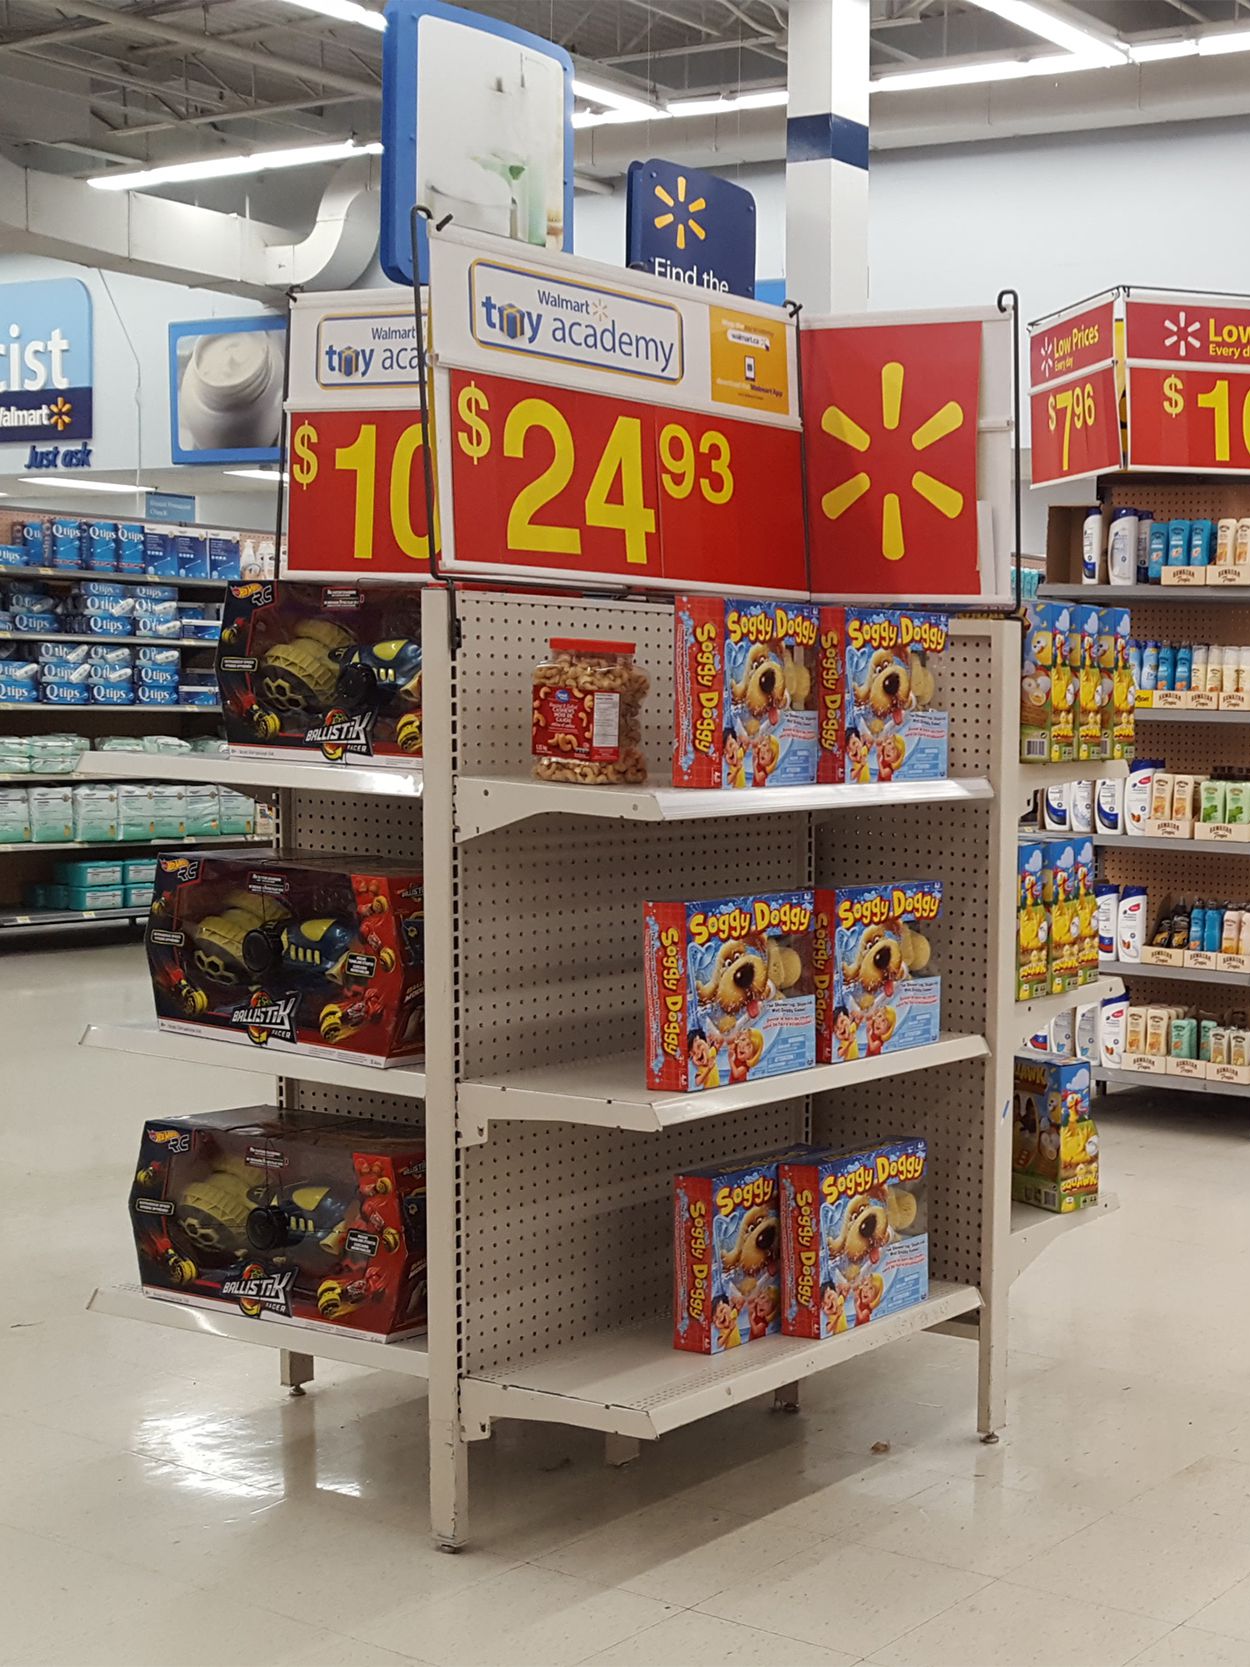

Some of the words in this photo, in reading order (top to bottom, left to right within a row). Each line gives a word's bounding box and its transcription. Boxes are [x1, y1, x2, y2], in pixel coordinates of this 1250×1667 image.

[655, 257, 697, 286] Find
[702, 269, 729, 292] the
[537, 289, 591, 316] Walmart
[371, 326, 416, 340] Walmart
[551, 315, 675, 373] academy
[1053, 336, 1072, 358] Low
[1072, 323, 1099, 351] Prices
[1209, 344, 1240, 359] Every
[25, 445, 59, 469] Just
[61, 441, 92, 467] ask
[727, 610, 774, 643] Soggy
[776, 609, 817, 645] Doggy
[848, 620, 898, 649] Soggy
[900, 617, 947, 652] Doggy
[696, 623, 717, 687] Soggy
[822, 631, 839, 689] Soggy
[696, 691, 719, 752] Doggy
[822, 694, 841, 751] Doggy
[689, 908, 751, 944] Soggy
[754, 901, 812, 934] Doggy
[838, 897, 890, 928] Soggy
[892, 890, 940, 920] Doggy
[661, 928, 679, 991] Soggy
[663, 995, 683, 1056] Doggy
[716, 1177, 774, 1217] Soggy
[822, 1166, 874, 1204] Soggy
[876, 1156, 923, 1184] Doggy
[690, 1200, 706, 1259] Soggy
[796, 1190, 812, 1246] Soggy
[690, 1264, 708, 1321] Doggy
[798, 1250, 816, 1307] Doggy
